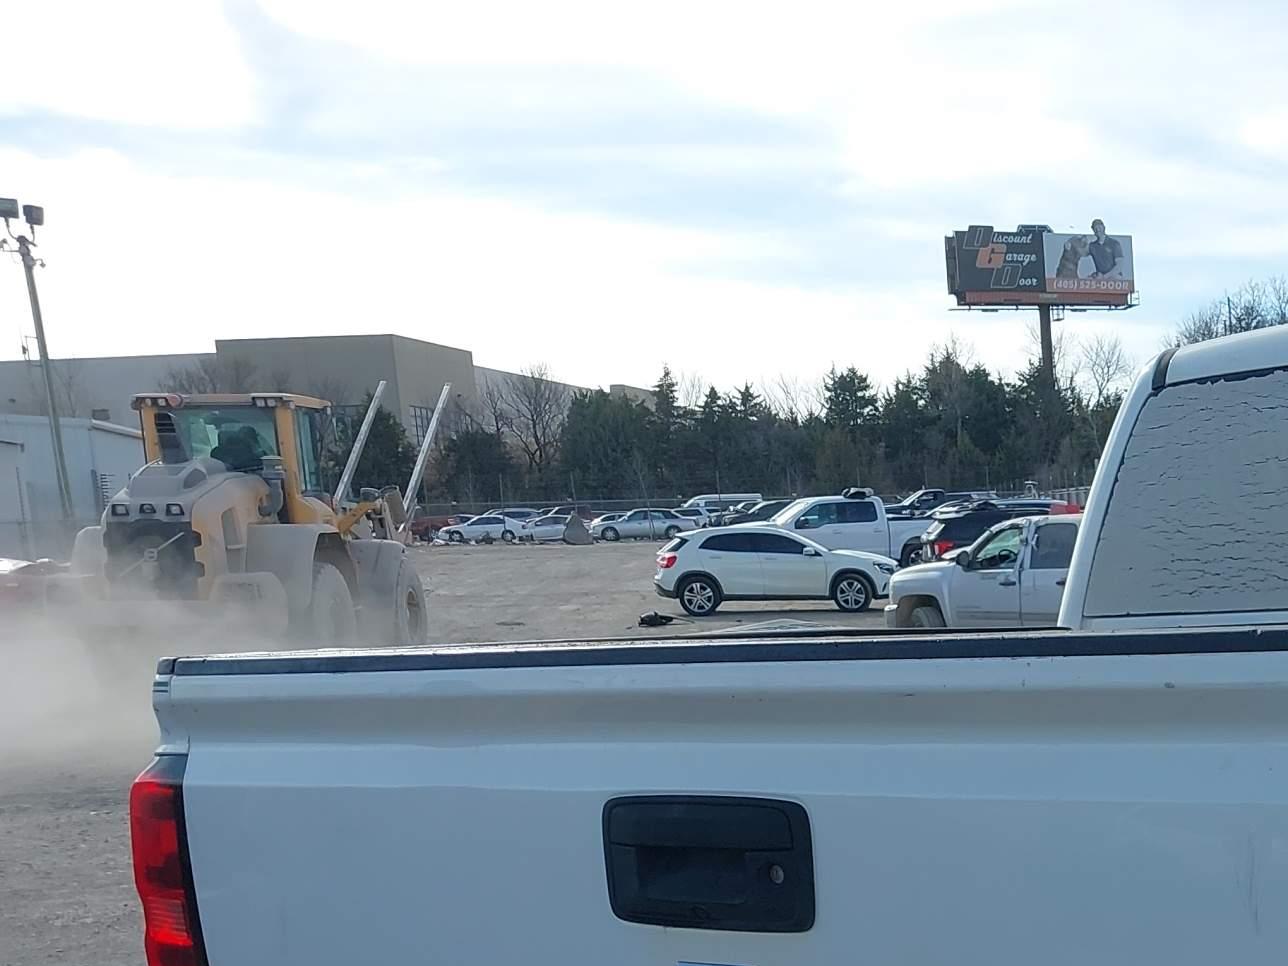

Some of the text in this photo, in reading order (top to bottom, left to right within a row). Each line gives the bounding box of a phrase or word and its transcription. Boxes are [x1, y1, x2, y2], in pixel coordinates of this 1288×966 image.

[962, 225, 1033, 250] Discount
[976, 243, 1037, 269] Garage
[990, 264, 1039, 289] Door
